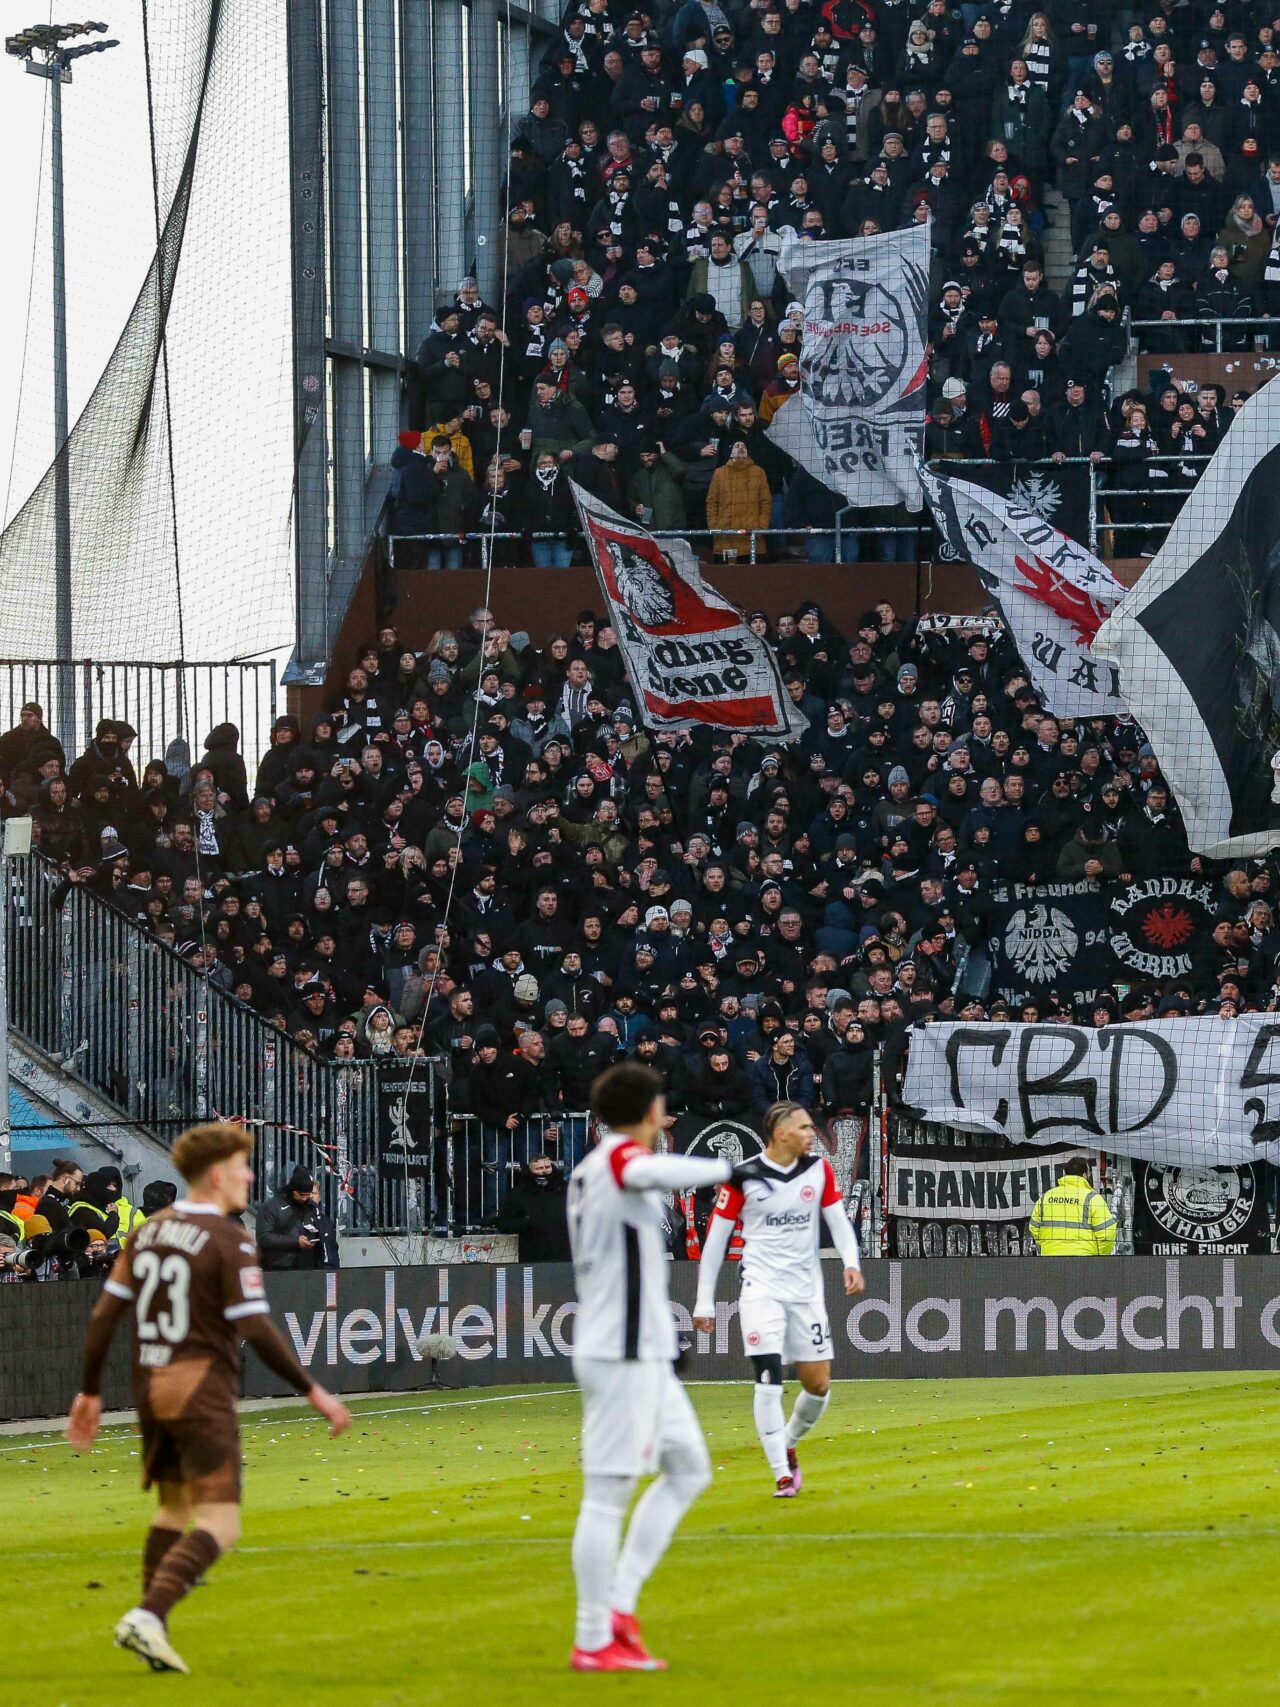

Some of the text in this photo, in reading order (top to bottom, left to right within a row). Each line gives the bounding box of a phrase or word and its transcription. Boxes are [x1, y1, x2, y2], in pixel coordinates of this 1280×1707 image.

[1014, 876, 1099, 900] Freunde
[1018, 928, 1062, 940] NIDDA
[1085, 930, 1104, 946] 94
[945, 1027, 1179, 1139] CBD
[1047, 1196, 1080, 1206] ORDNER
[765, 1213, 811, 1227] Indeed
[1152, 1243, 1250, 1255] OHNE FURCHT
[133, 1250, 191, 1344] 23
[846, 1262, 961, 1354] da
[984, 1258, 1243, 1353] macht
